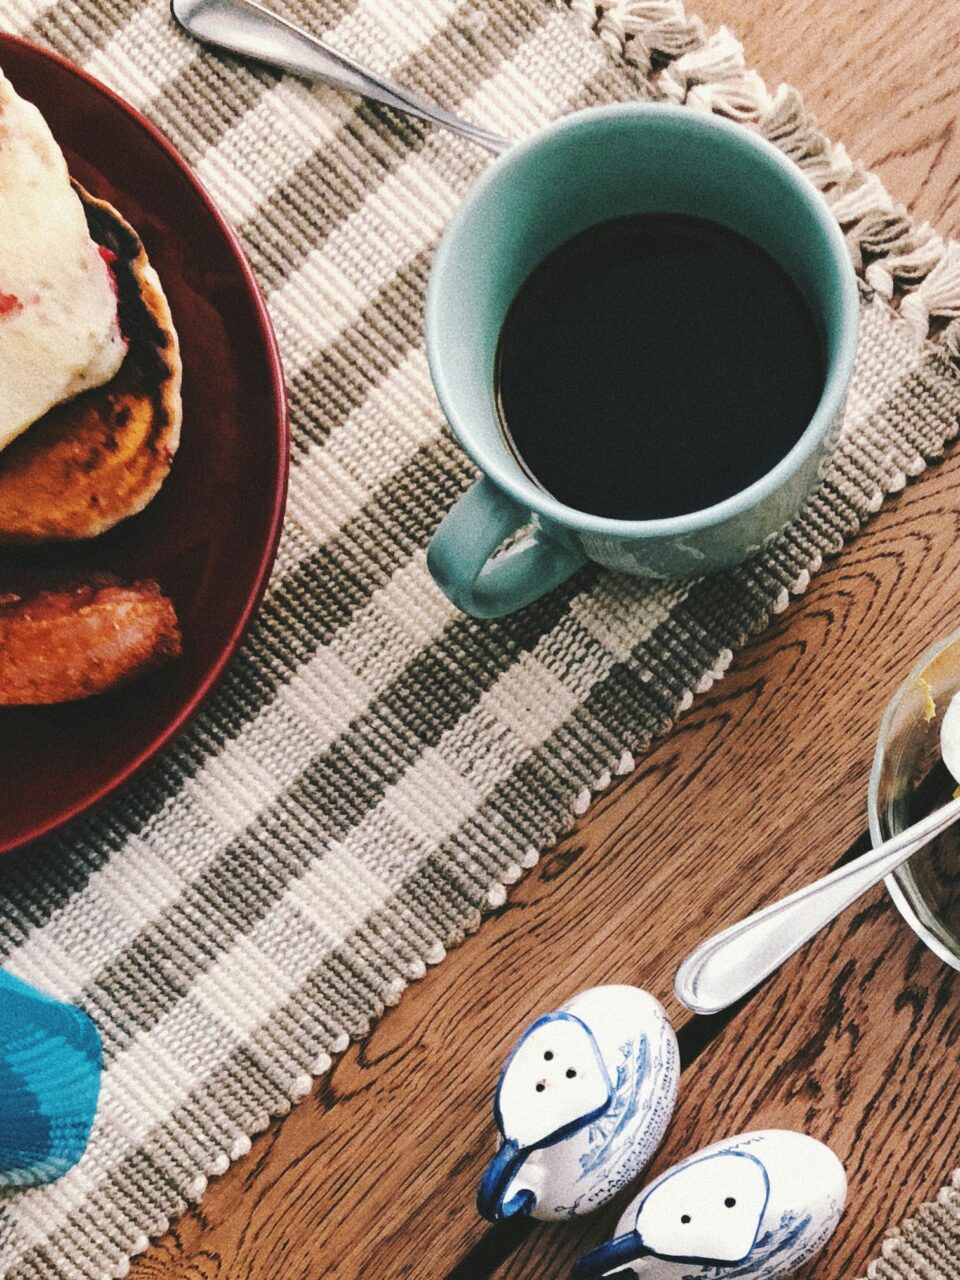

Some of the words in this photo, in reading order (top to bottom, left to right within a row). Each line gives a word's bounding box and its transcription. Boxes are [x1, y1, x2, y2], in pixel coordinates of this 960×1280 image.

[616, 1149, 637, 1175] LEFT
[638, 1096, 663, 1147] HANDED
[661, 1038, 671, 1092] SHAKER
